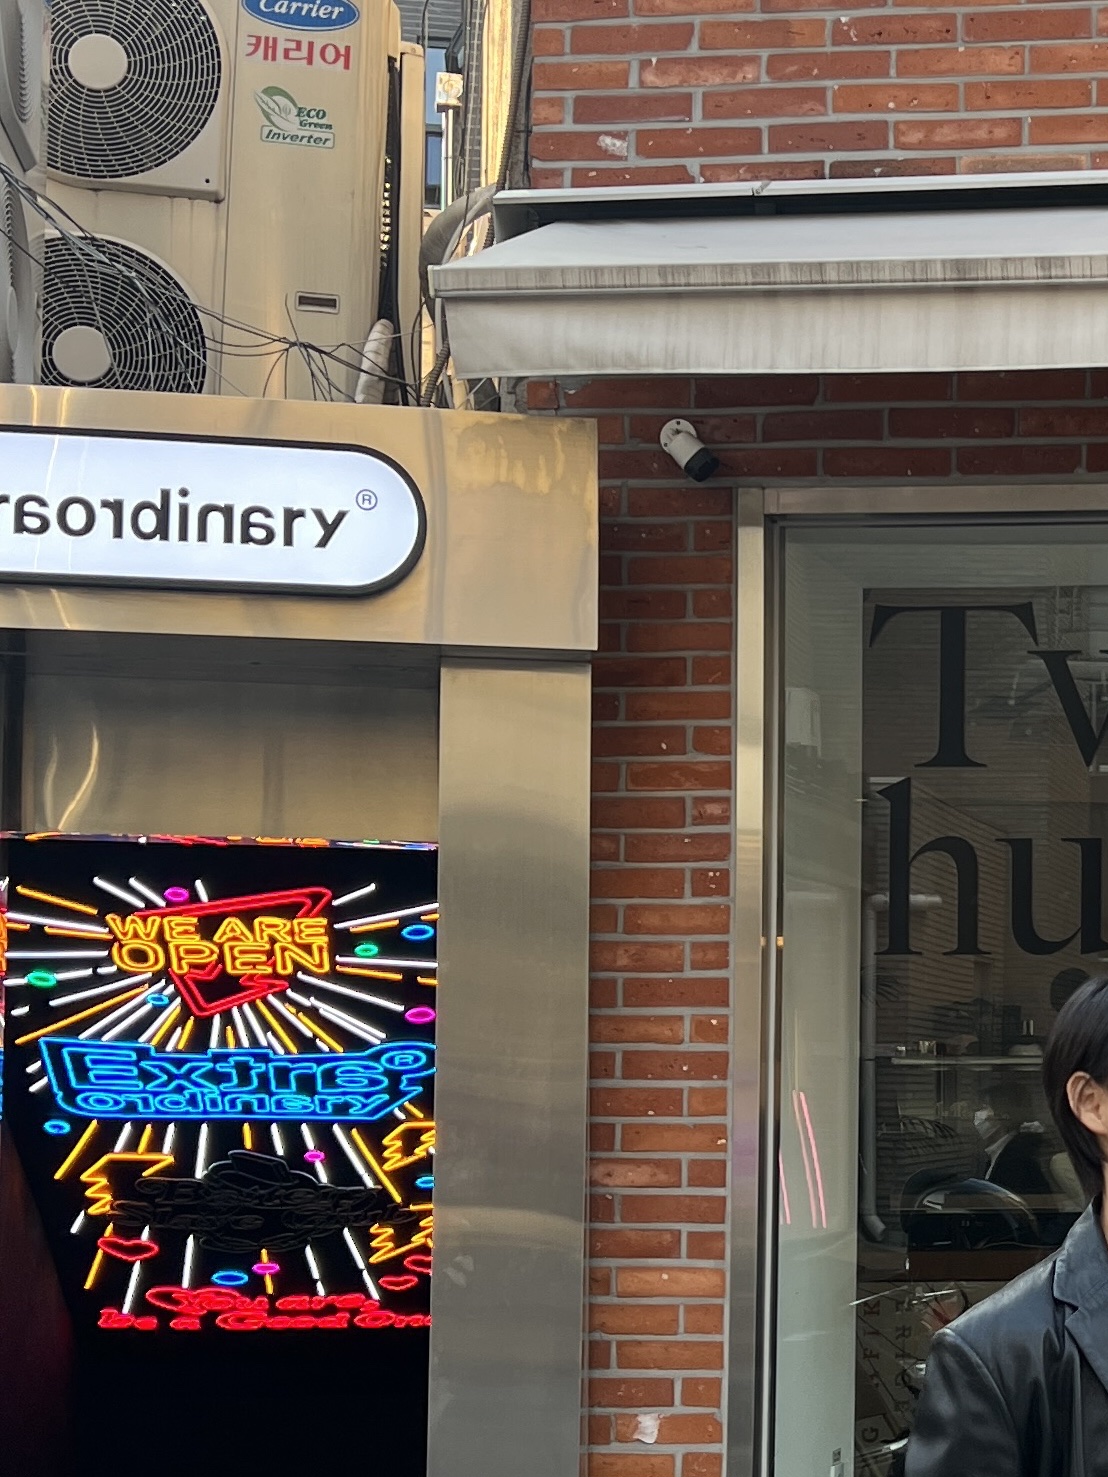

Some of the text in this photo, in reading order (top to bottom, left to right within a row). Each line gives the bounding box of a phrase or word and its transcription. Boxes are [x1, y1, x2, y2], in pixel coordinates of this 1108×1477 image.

[259, 0, 344, 20] Carrier
[245, 34, 351, 71] 캐리어
[295, 106, 327, 120] ECO
[299, 118, 333, 130] Green
[265, 128, 331, 146] Inverter
[105, 914, 329, 943] WE ARE
[112, 941, 330, 975] OPEN
